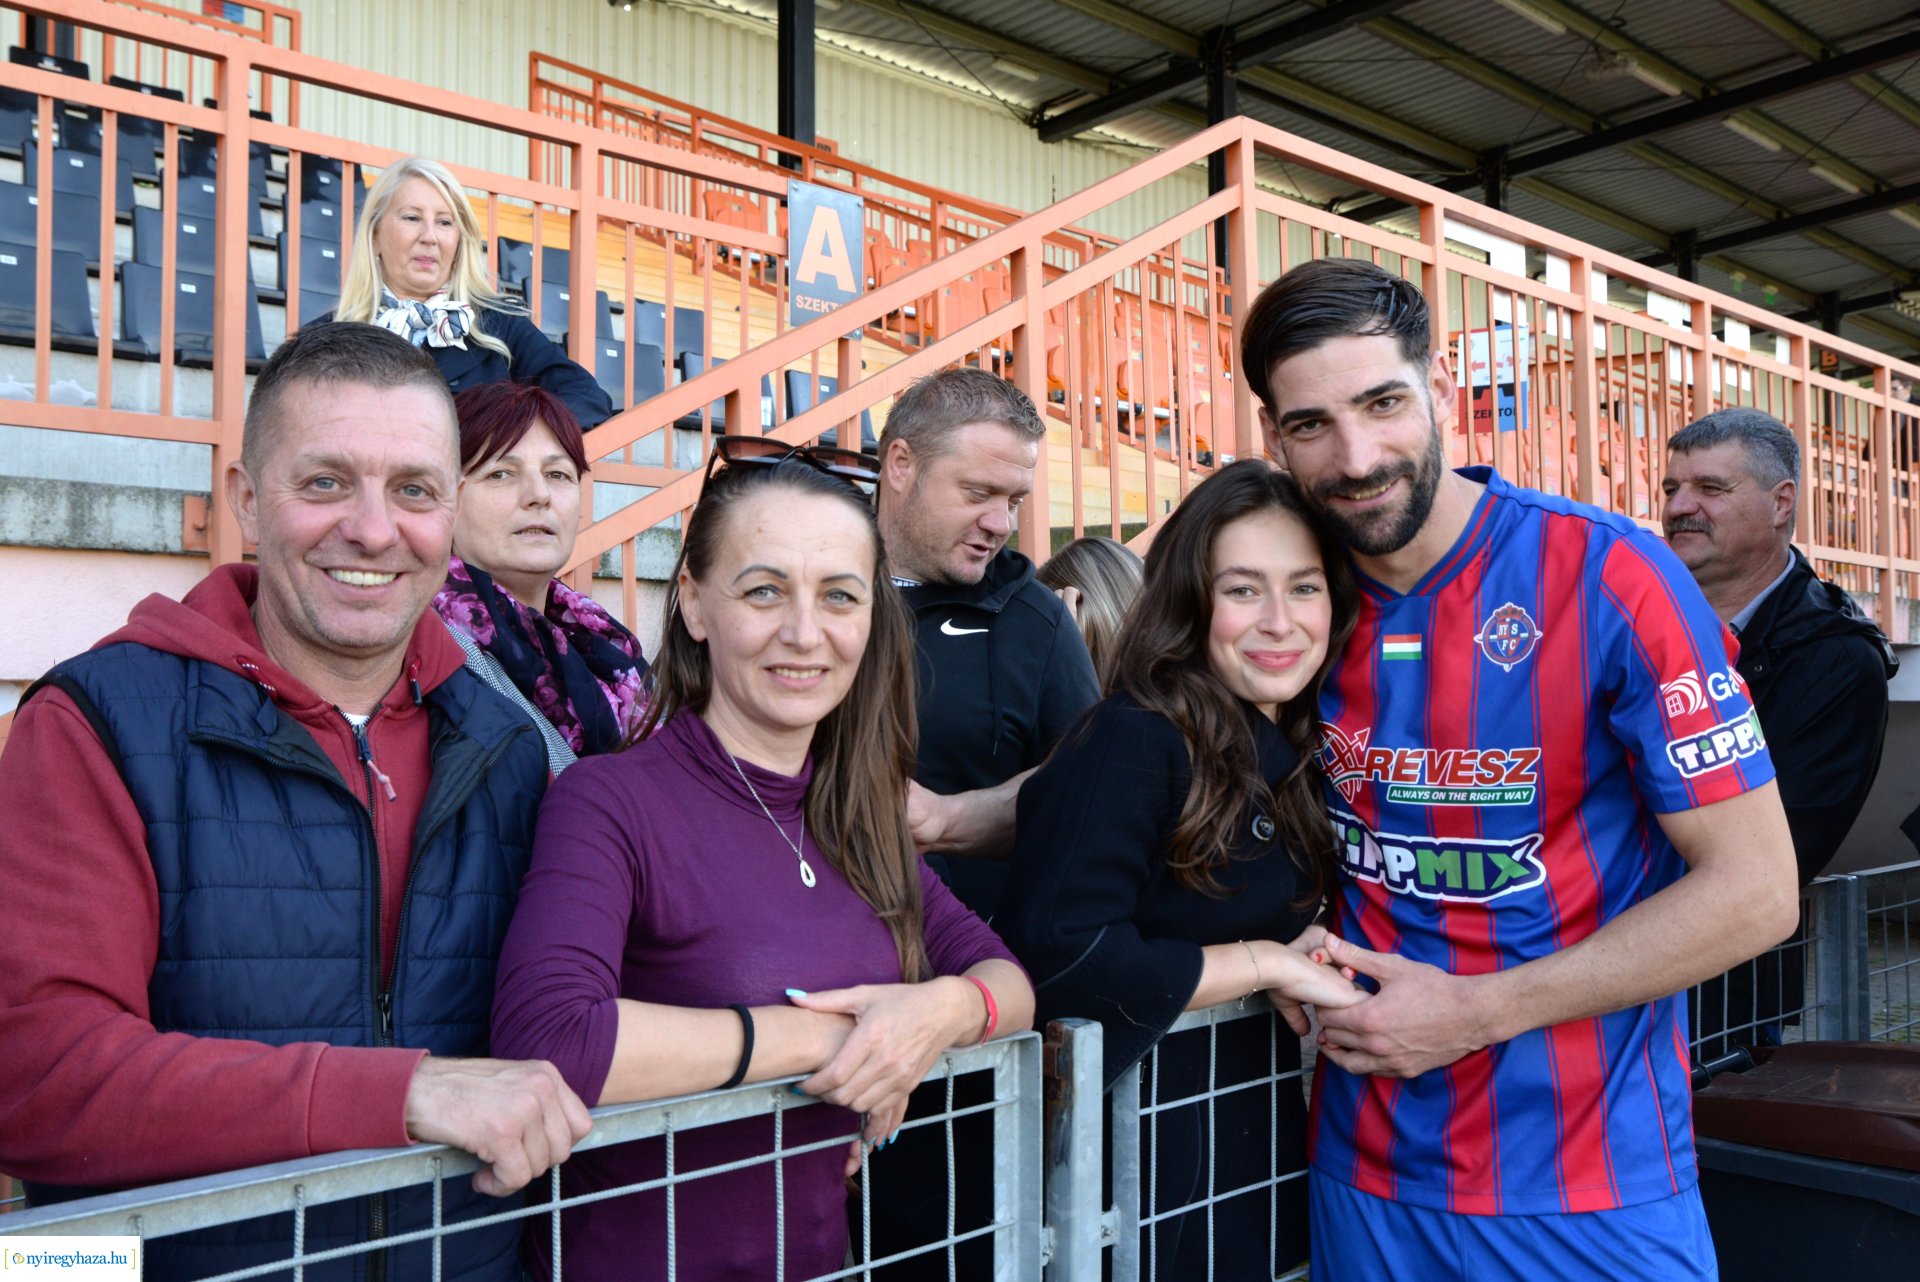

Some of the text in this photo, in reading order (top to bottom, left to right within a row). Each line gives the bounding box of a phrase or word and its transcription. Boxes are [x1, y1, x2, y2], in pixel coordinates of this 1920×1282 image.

[796, 205, 857, 293] A
[796, 294, 844, 313] SZEKT
[1391, 789, 1530, 801] ALWAYS ON THE RIGHT WAY
